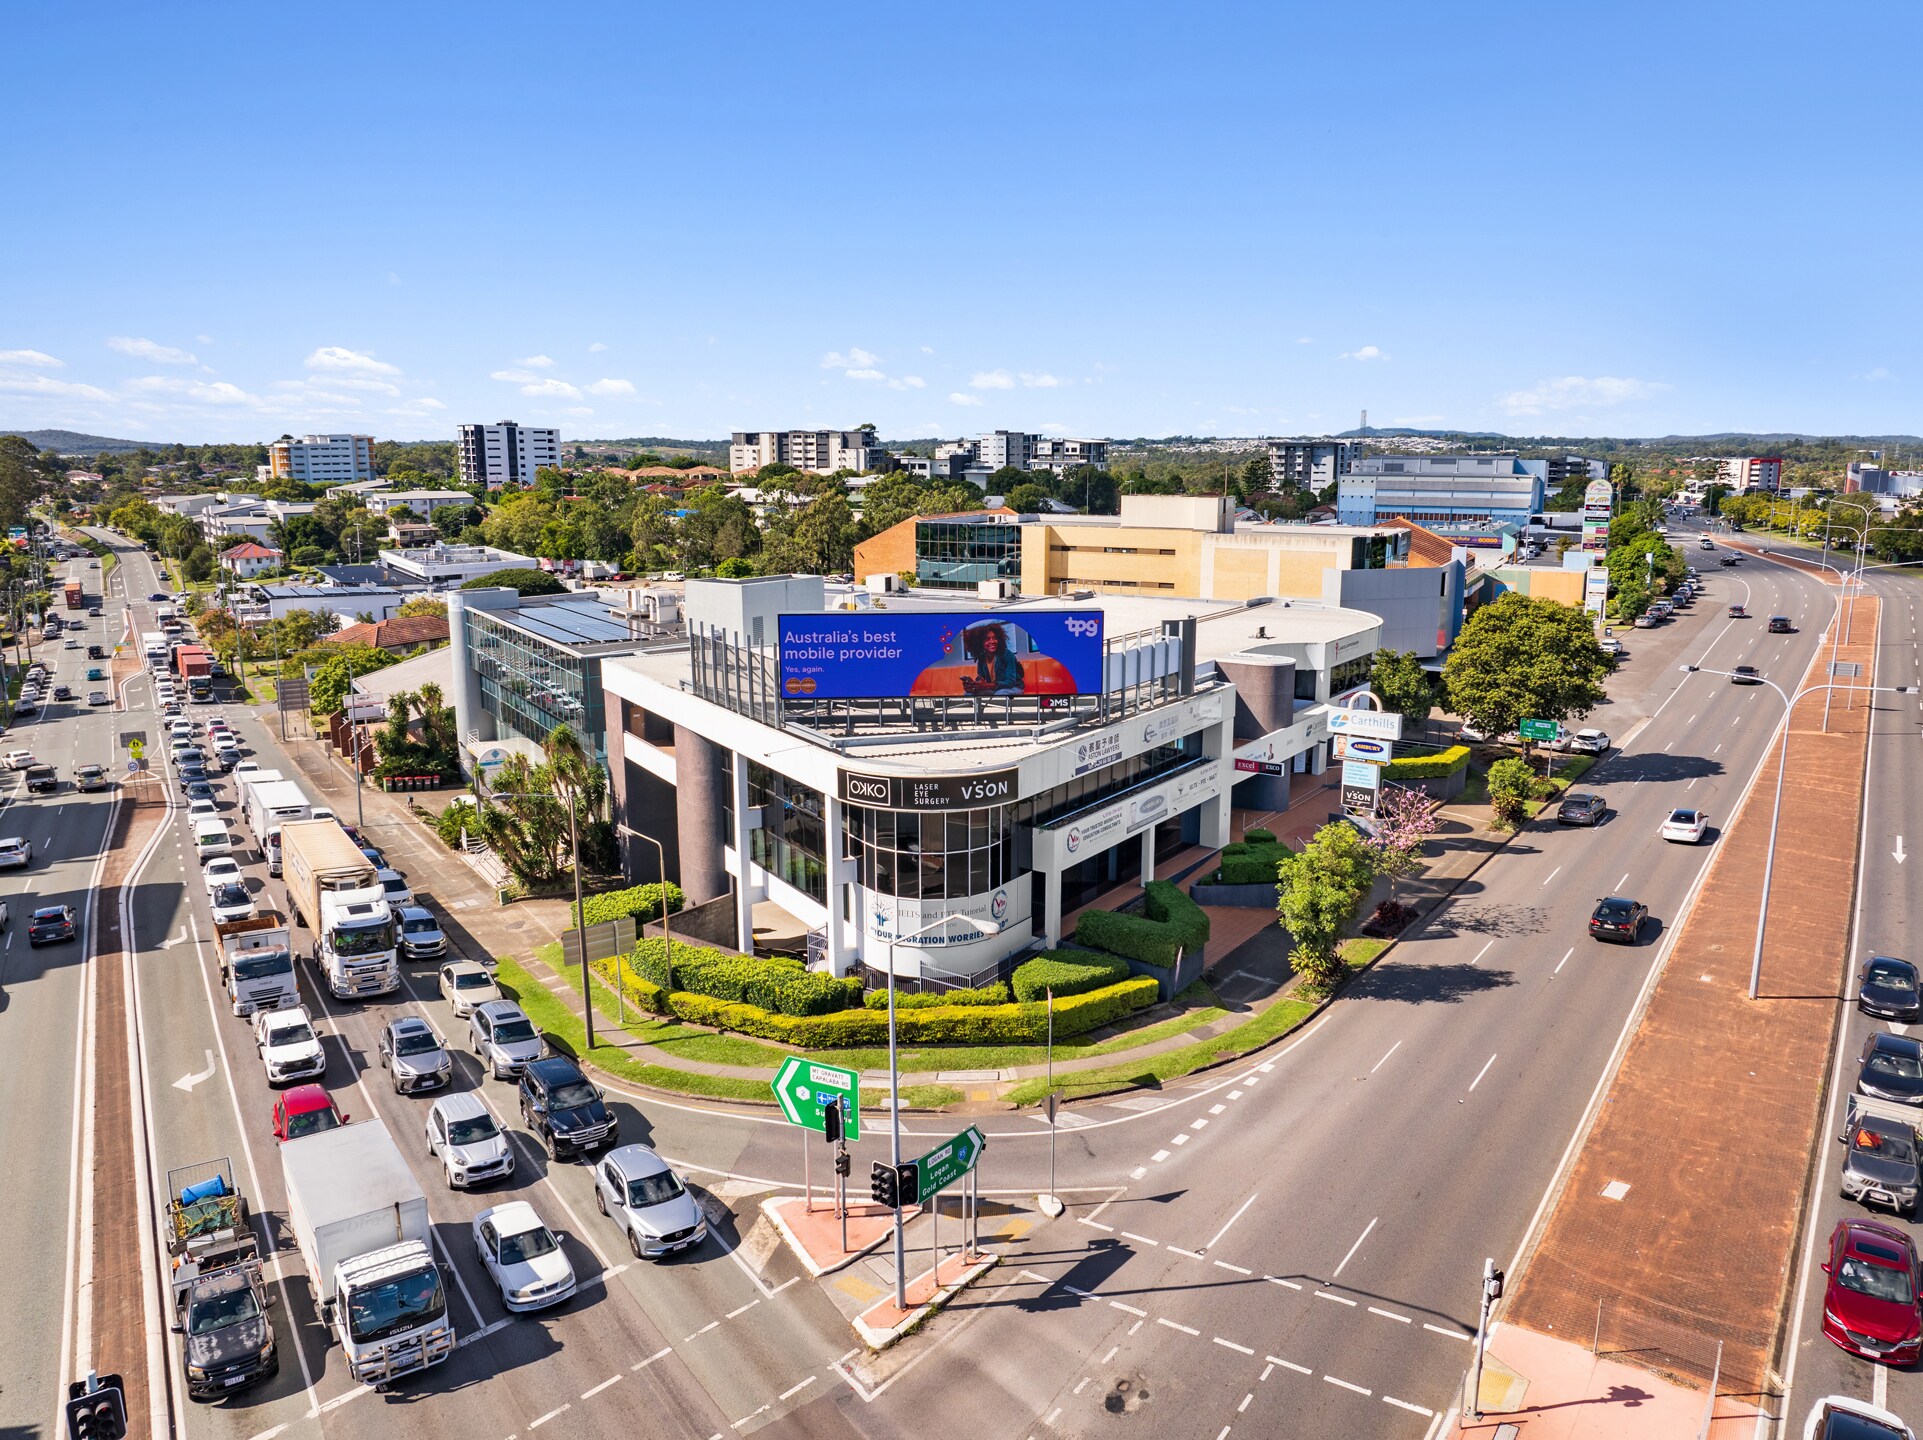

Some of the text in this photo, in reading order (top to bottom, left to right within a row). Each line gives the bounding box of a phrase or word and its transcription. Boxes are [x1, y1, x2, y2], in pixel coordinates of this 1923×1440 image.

[1064, 616, 1098, 637] tpg
[785, 630, 896, 644] Australia’s best
[785, 646, 902, 662] mobile provider
[785, 666, 800, 674] Yes,
[1050, 698, 1068, 706] QMS
[1352, 715, 1394, 729] Carthills
[899, 910, 920, 918] IELTS
[960, 905, 986, 916] Tutorial
[948, 932, 984, 943] WORRIES
[812, 1075, 840, 1085] CAPALABA
[821, 1070, 844, 1079] GRAVATT
[929, 1153, 943, 1166] LOGAN
[930, 1164, 949, 1180] Logan
[923, 1169, 956, 1196] Gold Coast
[390, 1324, 412, 1335] ISUZU
